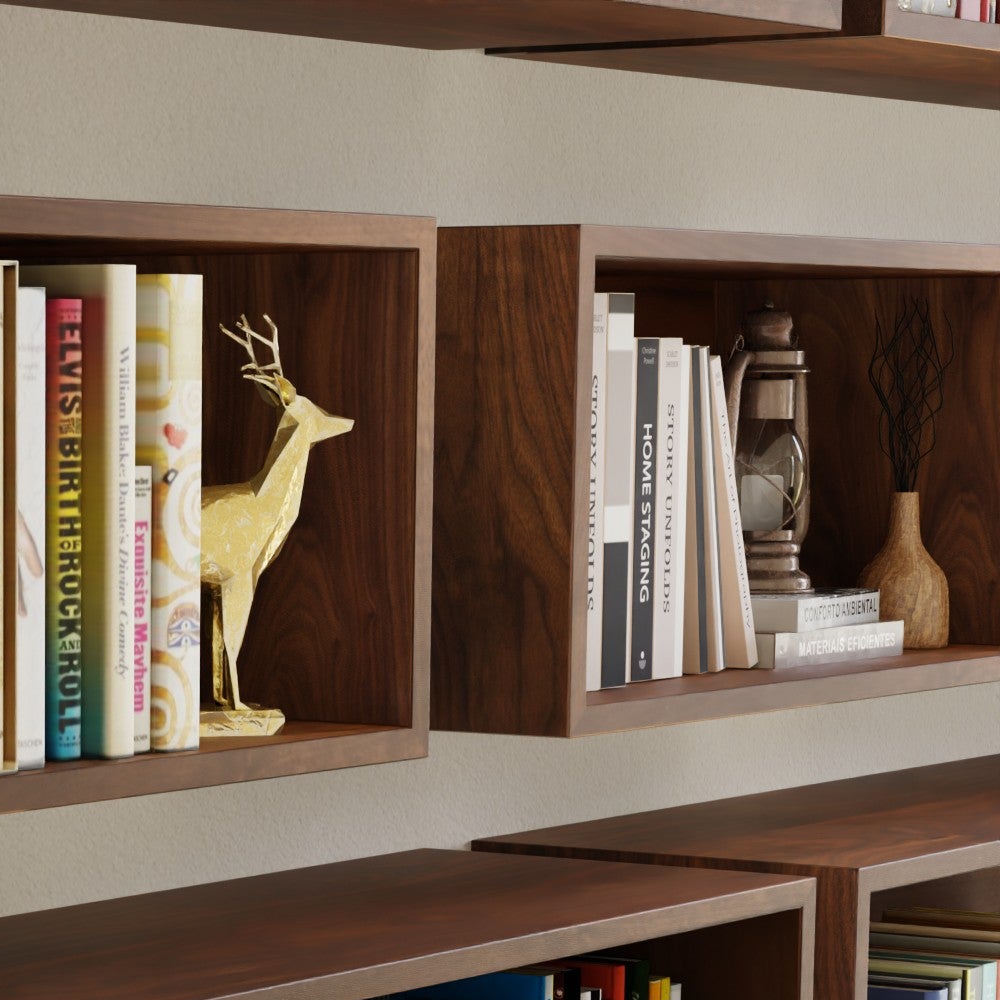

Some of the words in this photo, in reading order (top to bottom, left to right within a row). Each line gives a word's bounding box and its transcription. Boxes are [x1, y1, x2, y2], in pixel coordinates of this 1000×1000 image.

[59, 322, 81, 414] ELVIS
[119, 347, 130, 419] William
[119, 425, 130, 476] Blake:
[641, 424, 654, 496] HOME
[666, 403, 675, 485] STORY
[58, 437, 81, 537] BIRTH
[60, 540, 80, 550] OF
[119, 549, 130, 606] Divine
[639, 501, 651, 602] STAGING
[663, 496, 673, 612] UNFOLDS
[58, 551, 81, 640] ROCK
[841, 598, 877, 616] AMBIENTAL
[115, 610, 130, 681] Comedy
[134, 622, 149, 713] Mayhem
[798, 639, 844, 656] MATERIAIS
[847, 632, 896, 651] EFICIENTES
[58, 652, 81, 735] ROLL
